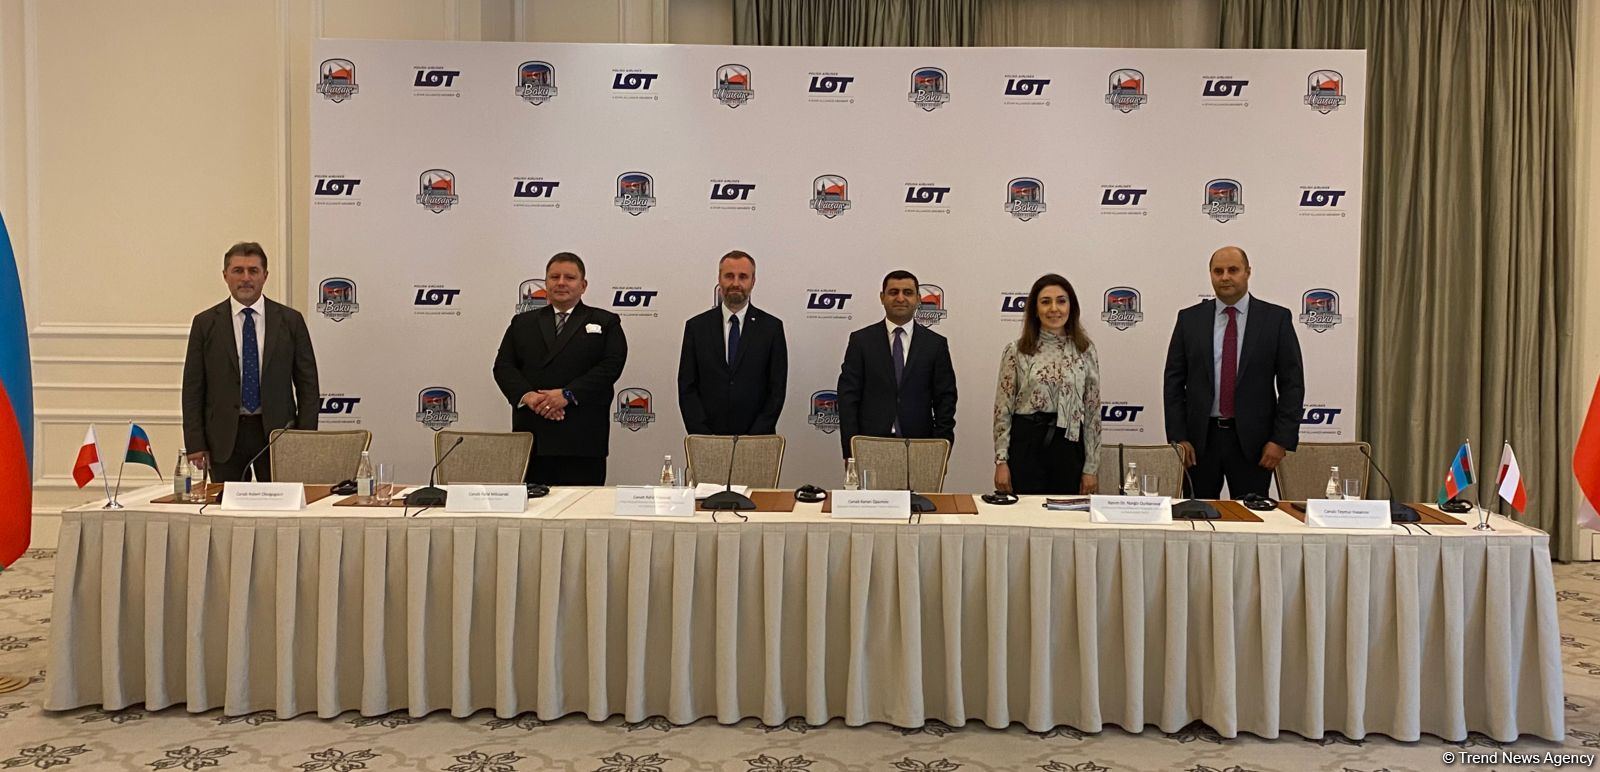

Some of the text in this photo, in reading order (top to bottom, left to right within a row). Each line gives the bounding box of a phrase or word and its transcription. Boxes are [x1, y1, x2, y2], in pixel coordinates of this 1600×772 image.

[413, 71, 460, 87] LOT
[613, 74, 658, 89] LOT
[809, 77, 854, 93] LOT
[523, 83, 549, 96] Baku
[1005, 80, 1050, 95] LOT
[1203, 81, 1249, 96] LOT
[916, 89, 941, 102] Baku
[315, 180, 361, 195] LOT
[514, 182, 560, 197] LOT
[711, 184, 756, 200] LOT
[906, 187, 951, 203] LOT
[622, 194, 648, 206] Baku
[1102, 189, 1147, 205] LOT
[1300, 191, 1346, 206] LOT
[1013, 200, 1038, 212] Baku
[1210, 202, 1236, 214] Baku
[415, 289, 460, 305] LOT
[613, 291, 658, 307] LOT
[808, 294, 852, 309] LOT
[1001, 296, 1026, 312] LO
[325, 300, 351, 312] Baku
[1109, 309, 1135, 321] Baku
[1308, 311, 1333, 323] Baku
[424, 410, 450, 422] Baku
[1101, 406, 1144, 422] LOT
